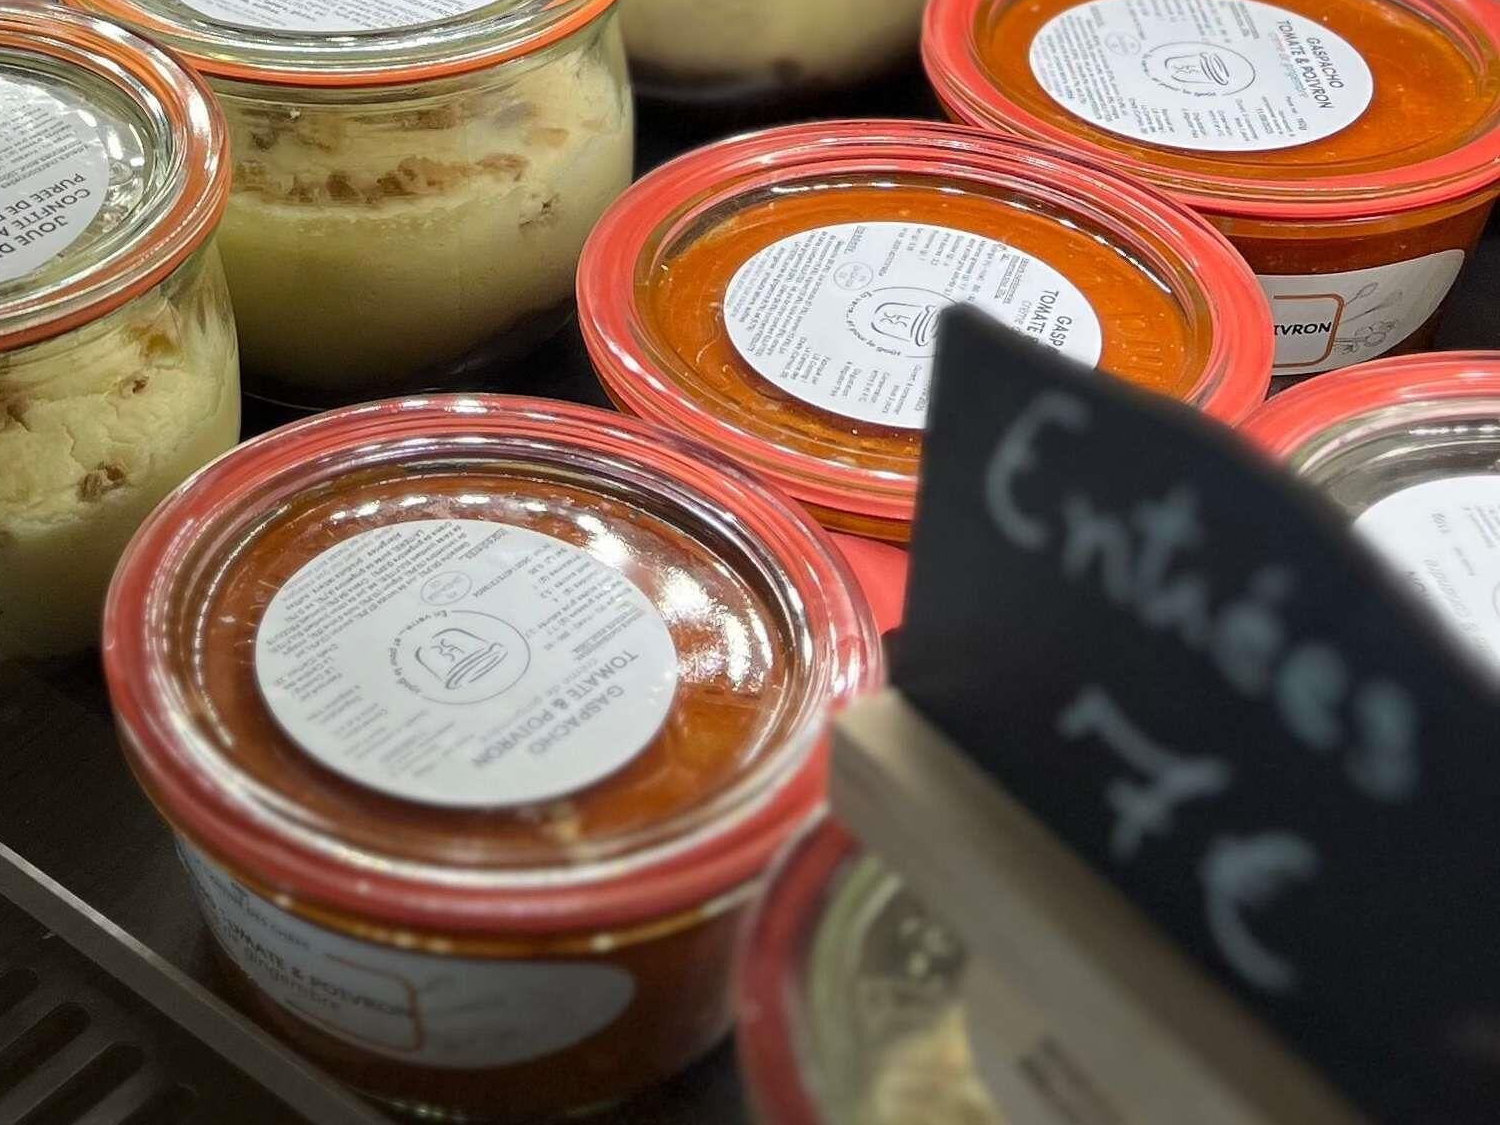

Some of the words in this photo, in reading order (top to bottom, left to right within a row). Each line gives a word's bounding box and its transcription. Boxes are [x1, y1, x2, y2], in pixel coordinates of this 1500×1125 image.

[1276, 19, 1312, 56] TOMATE
[1300, 65, 1333, 109] POIVRON
[1305, 36, 1344, 88] GASPACHO
[4, 198, 32, 216] DE
[10, 187, 90, 230] CONFITE
[28, 172, 86, 203] PUREE
[13, 214, 68, 246] JOUE
[1026, 289, 1059, 333] TOMATE
[1044, 314, 1073, 347] GASP
[565, 650, 638, 700] TOMATE
[471, 709, 553, 768] POIVRON
[527, 685, 623, 755] GASPACHO
